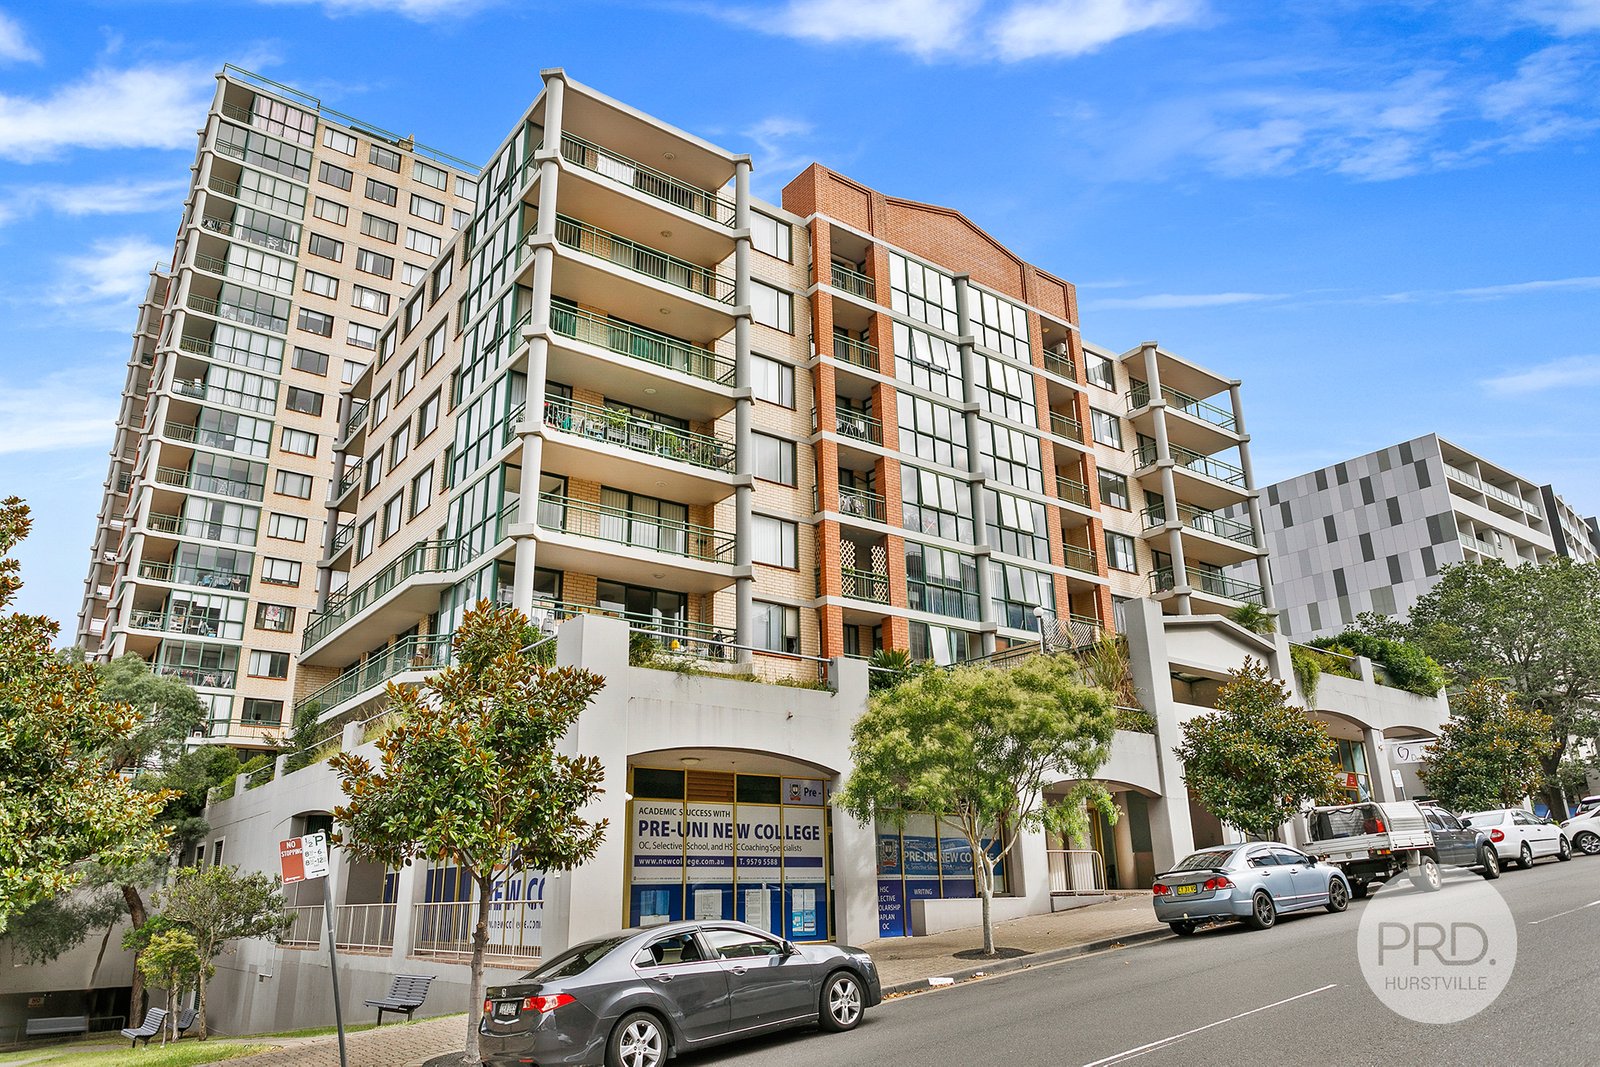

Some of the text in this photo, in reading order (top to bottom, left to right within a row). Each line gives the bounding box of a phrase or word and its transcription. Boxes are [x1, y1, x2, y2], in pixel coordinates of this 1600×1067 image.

[638, 806, 731, 818] ACADEMIC SUCCESS WITH
[638, 820, 820, 841] PRE-UNI NEW COLLEGE
[286, 841, 296, 849] NO
[315, 835, 323, 846] P
[638, 841, 803, 854] OC, Selective School, and HSC Coaching Specialists
[281, 848, 303, 857] STOPPING
[904, 851, 938, 863] PRE-UN
[638, 858, 725, 867] www.newcolege.com.au
[746, 858, 762, 866] 9579
[913, 888, 933, 896] WRITING
[878, 895, 896, 903] ECTIVE
[878, 904, 901, 912] OLARSHIP
[882, 922, 890, 930] OC
